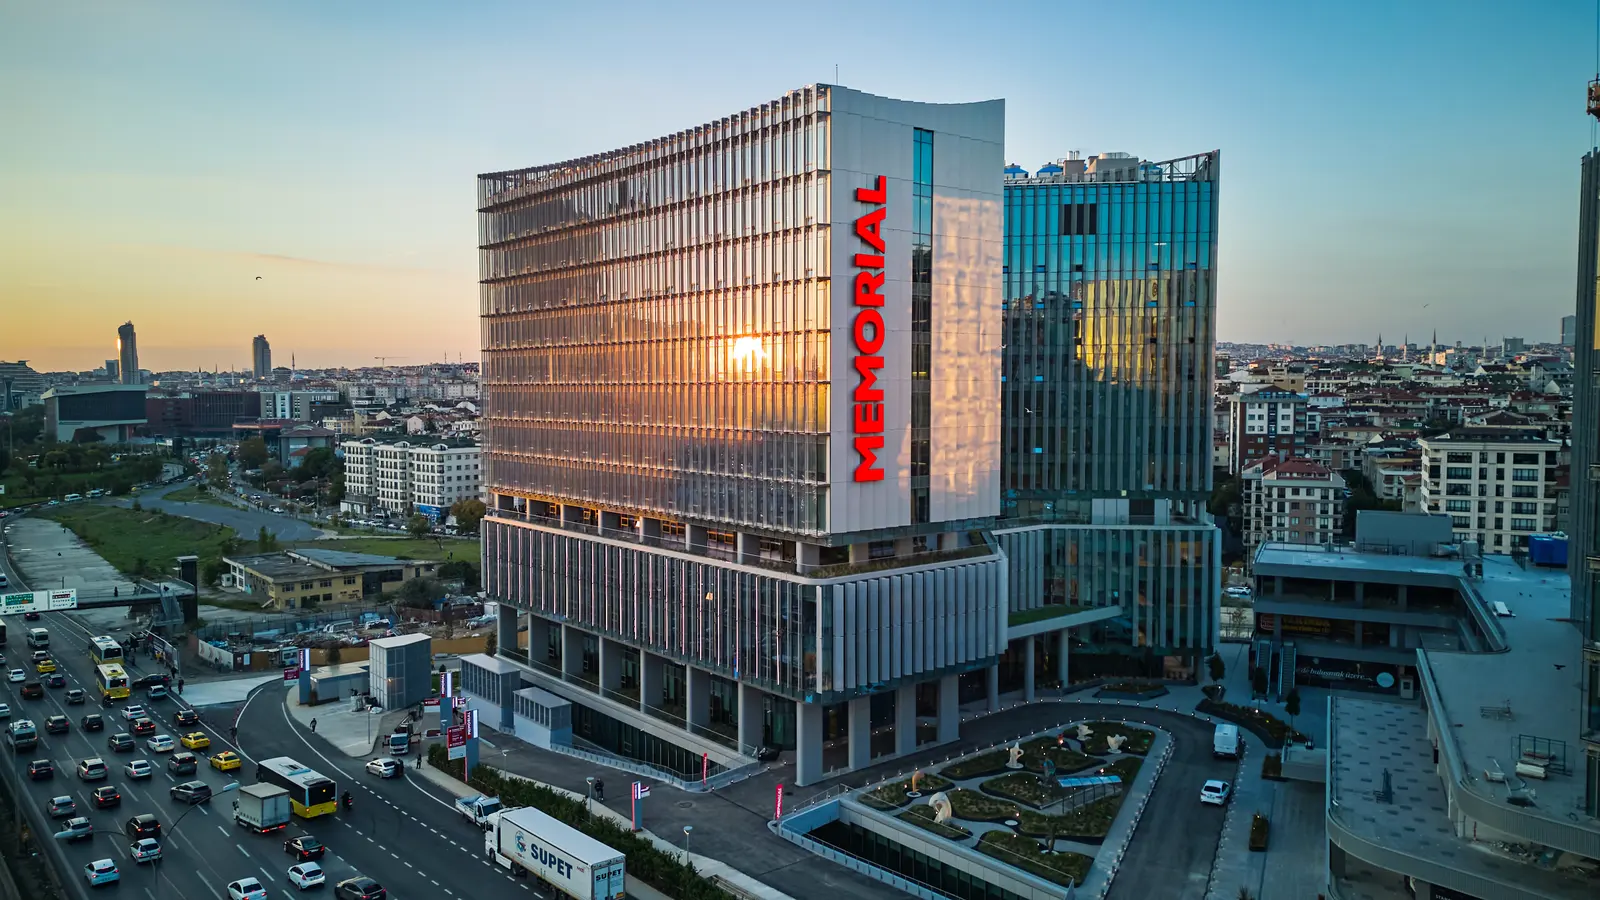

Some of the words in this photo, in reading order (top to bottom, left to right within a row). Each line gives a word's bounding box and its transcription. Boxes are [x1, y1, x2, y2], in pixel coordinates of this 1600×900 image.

[854, 175, 887, 482] MEMORIAL
[531, 843, 573, 880] SUPET
[596, 868, 622, 881] SUPET
